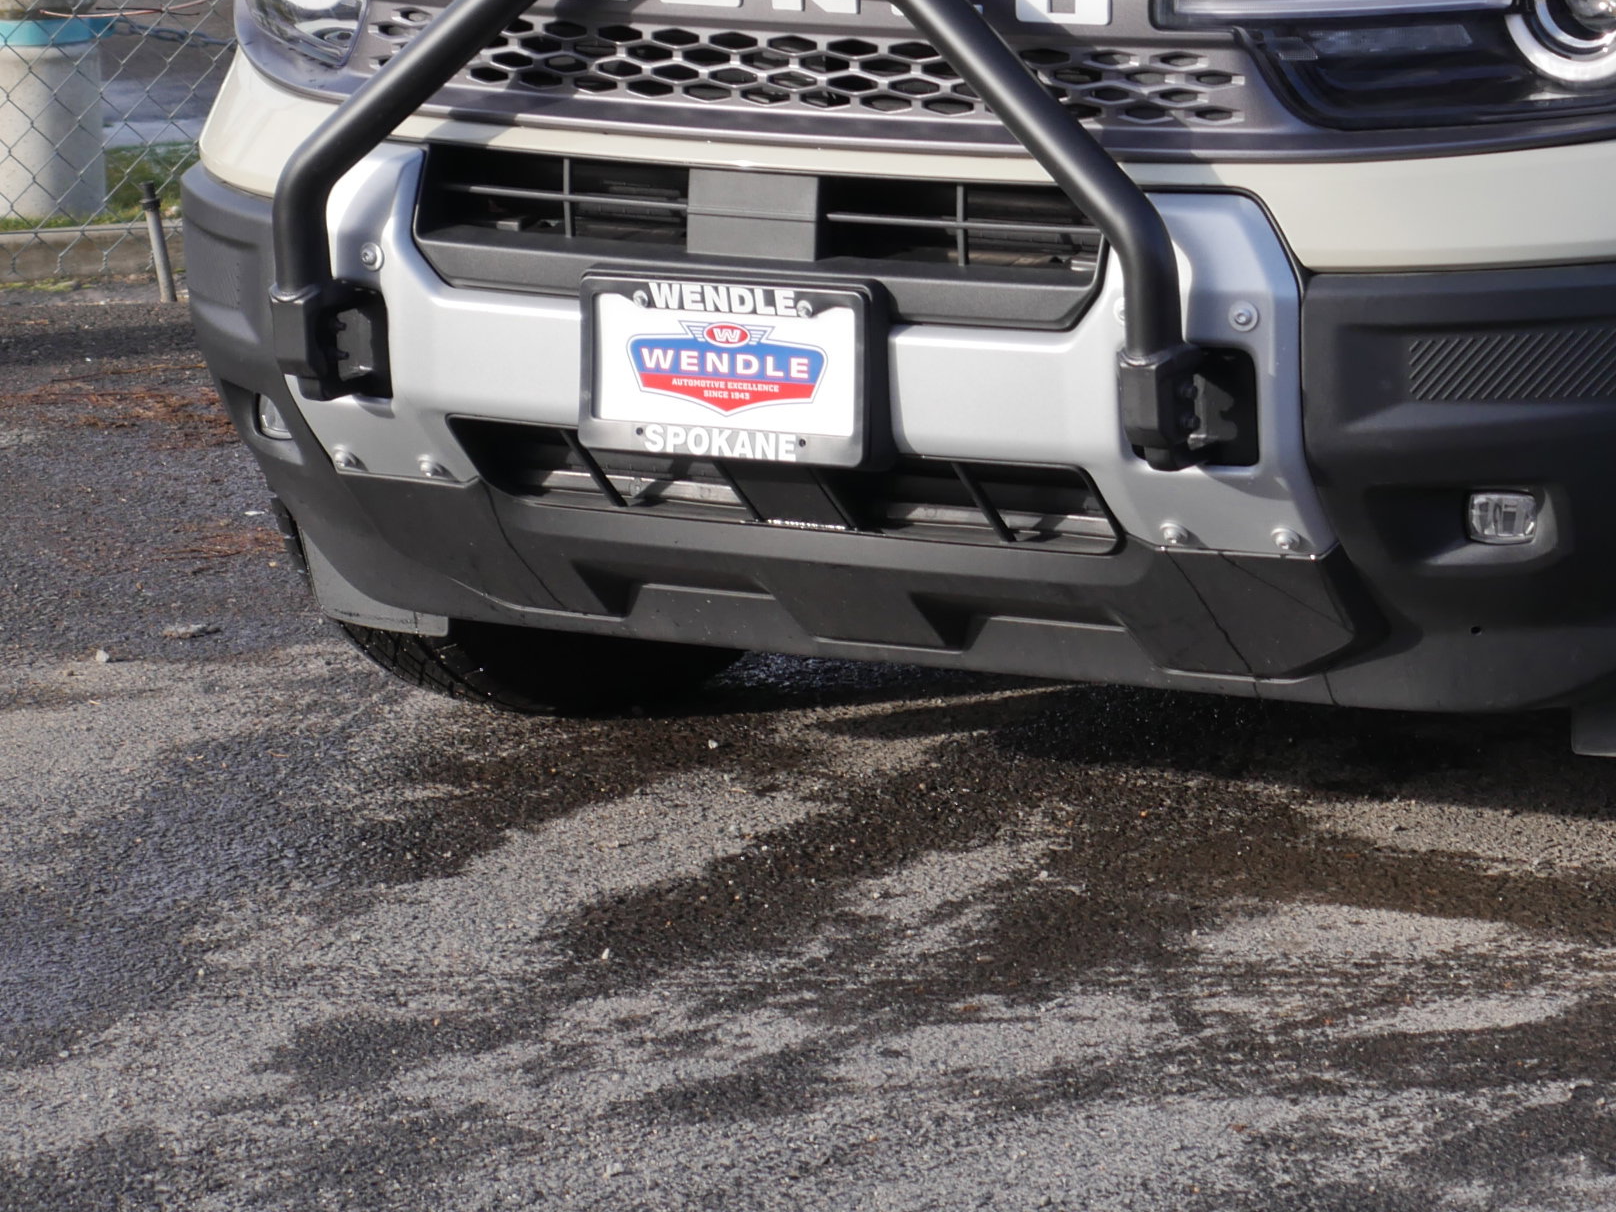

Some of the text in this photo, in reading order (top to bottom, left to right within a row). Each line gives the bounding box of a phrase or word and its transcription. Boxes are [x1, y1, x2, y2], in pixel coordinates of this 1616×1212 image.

[649, 282, 797, 316] WENDLE
[640, 347, 809, 379] WENDLE
[671, 377, 780, 393] AUTOMOTIVE EXCELLENCE
[703, 390, 729, 399] SINCE
[644, 423, 797, 462] SPOKANE
